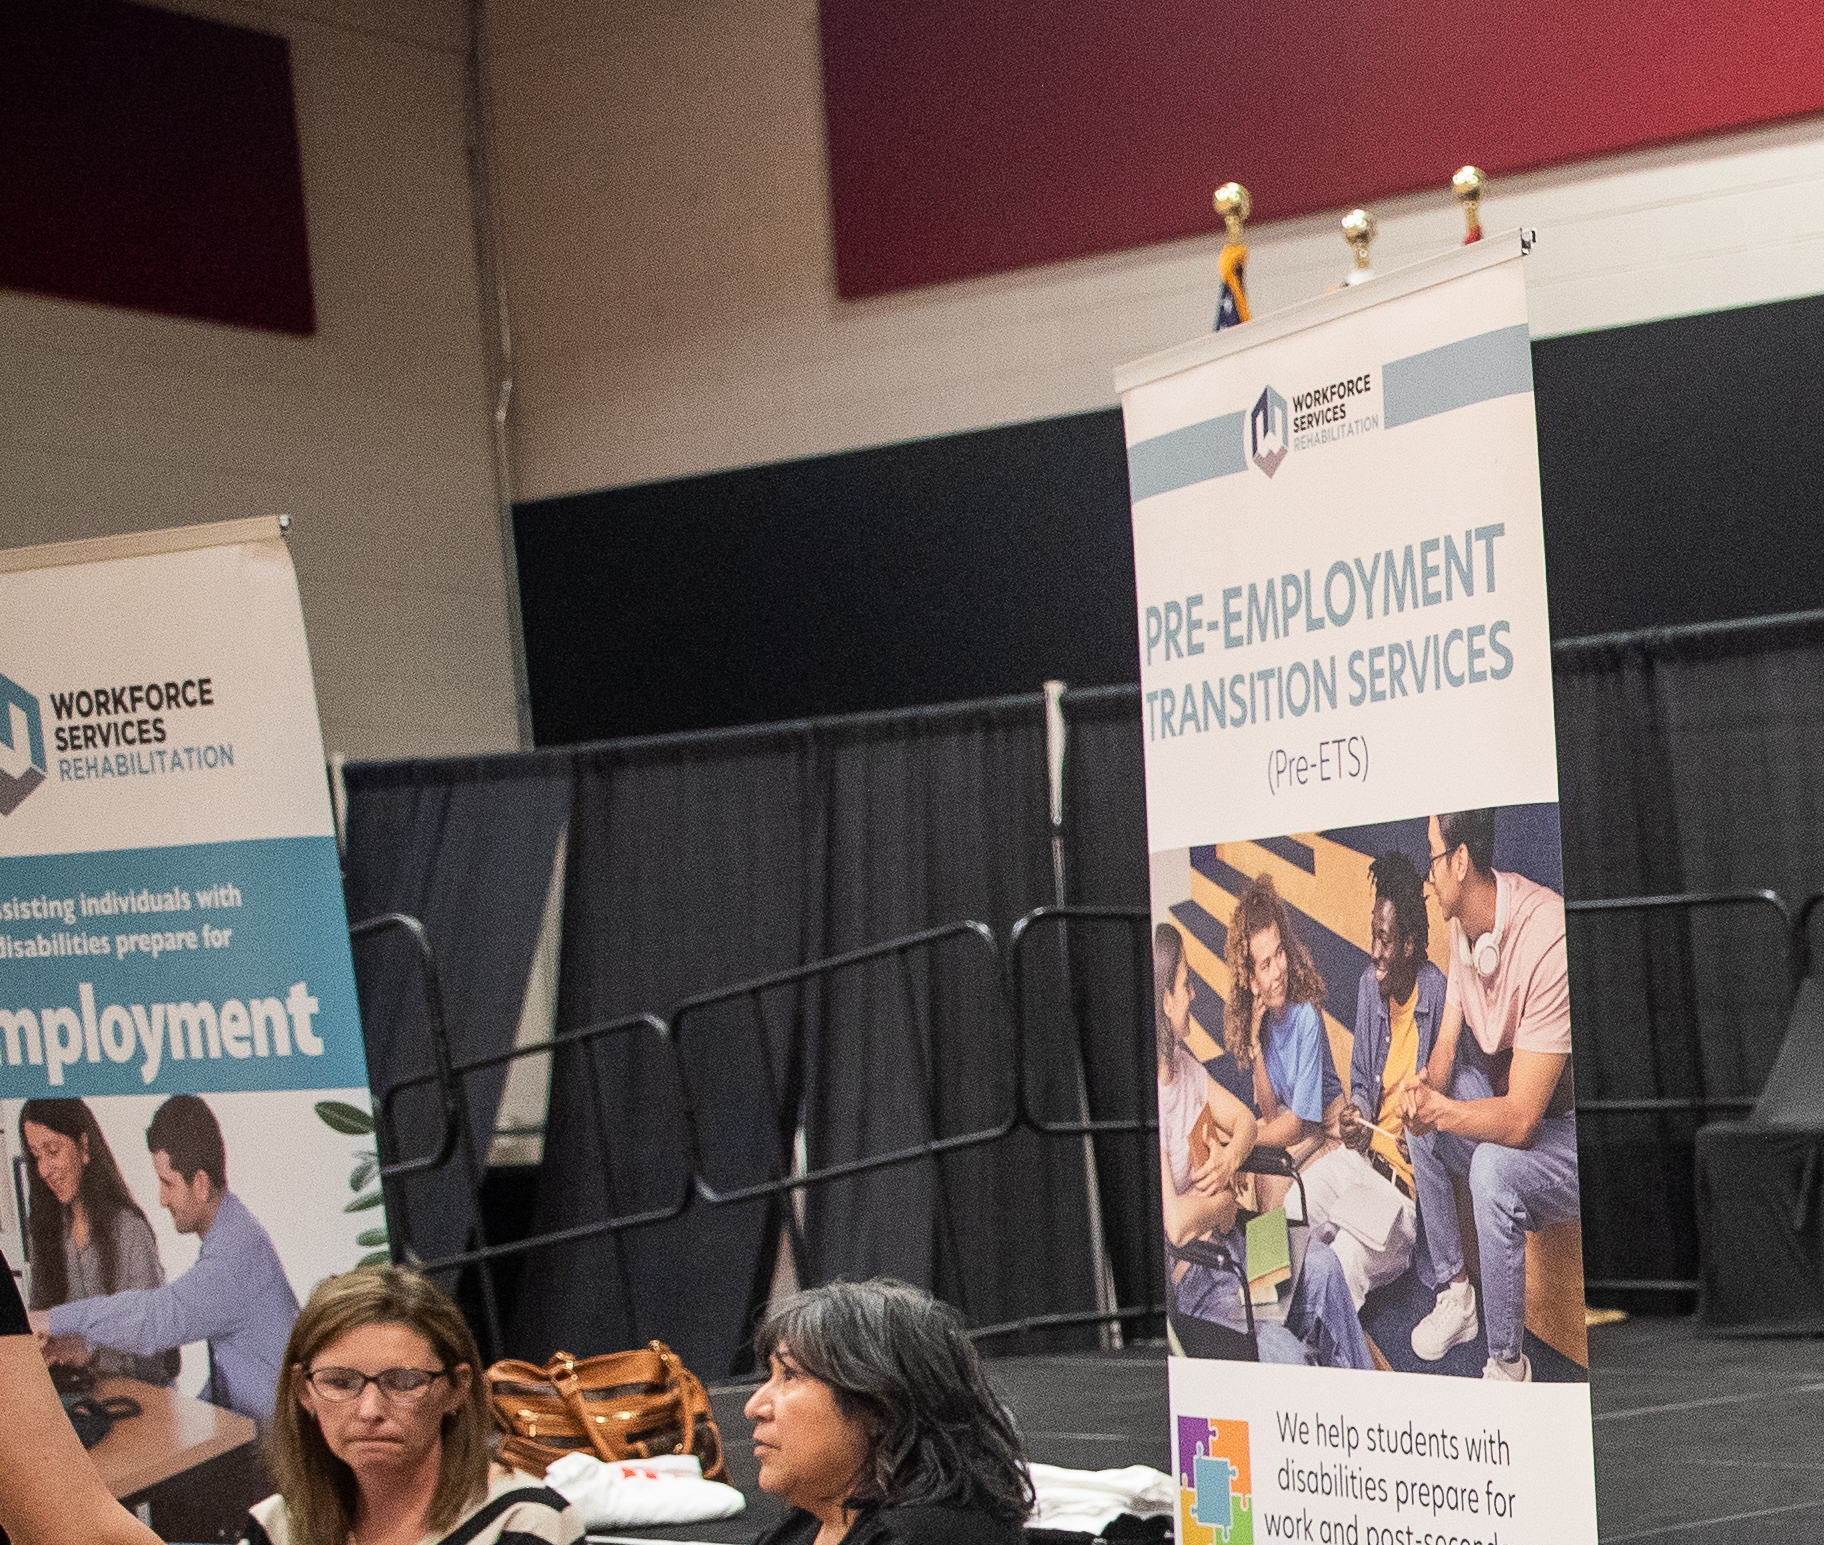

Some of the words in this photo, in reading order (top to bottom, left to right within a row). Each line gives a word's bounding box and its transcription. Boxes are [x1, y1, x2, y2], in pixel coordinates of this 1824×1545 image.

[1293, 373, 1372, 412] WORKFORCE
[1293, 403, 1346, 433] SERVICES
[1294, 414, 1379, 452] REHABILITATION
[1146, 522, 1505, 664] PRE-EMPLOYMENT
[50, 678, 215, 720] WORKFORCE
[1146, 656, 1338, 741] TRANSITION
[1347, 620, 1515, 707] SERVICES
[55, 719, 167, 753] SERVICES
[59, 744, 235, 782] REHABILITATION
[1268, 735, 1369, 794] (Pre-ETS)
[0, 894, 77, 925] sisting
[80, 886, 191, 918] individuals
[195, 884, 242, 909] with
[115, 929, 198, 961] prepare
[202, 924, 233, 948] for
[0, 981, 324, 1086] mployment
[1276, 1411, 1311, 1446] We
[1316, 1414, 1360, 1451] help
[1366, 1420, 1461, 1461] students
[1465, 1429, 1511, 1467] with
[1278, 1458, 1388, 1504] disabilities
[1395, 1480, 1480, 1517] prepare
[1485, 1480, 1516, 1518] for
[1264, 1508, 1313, 1543] work
